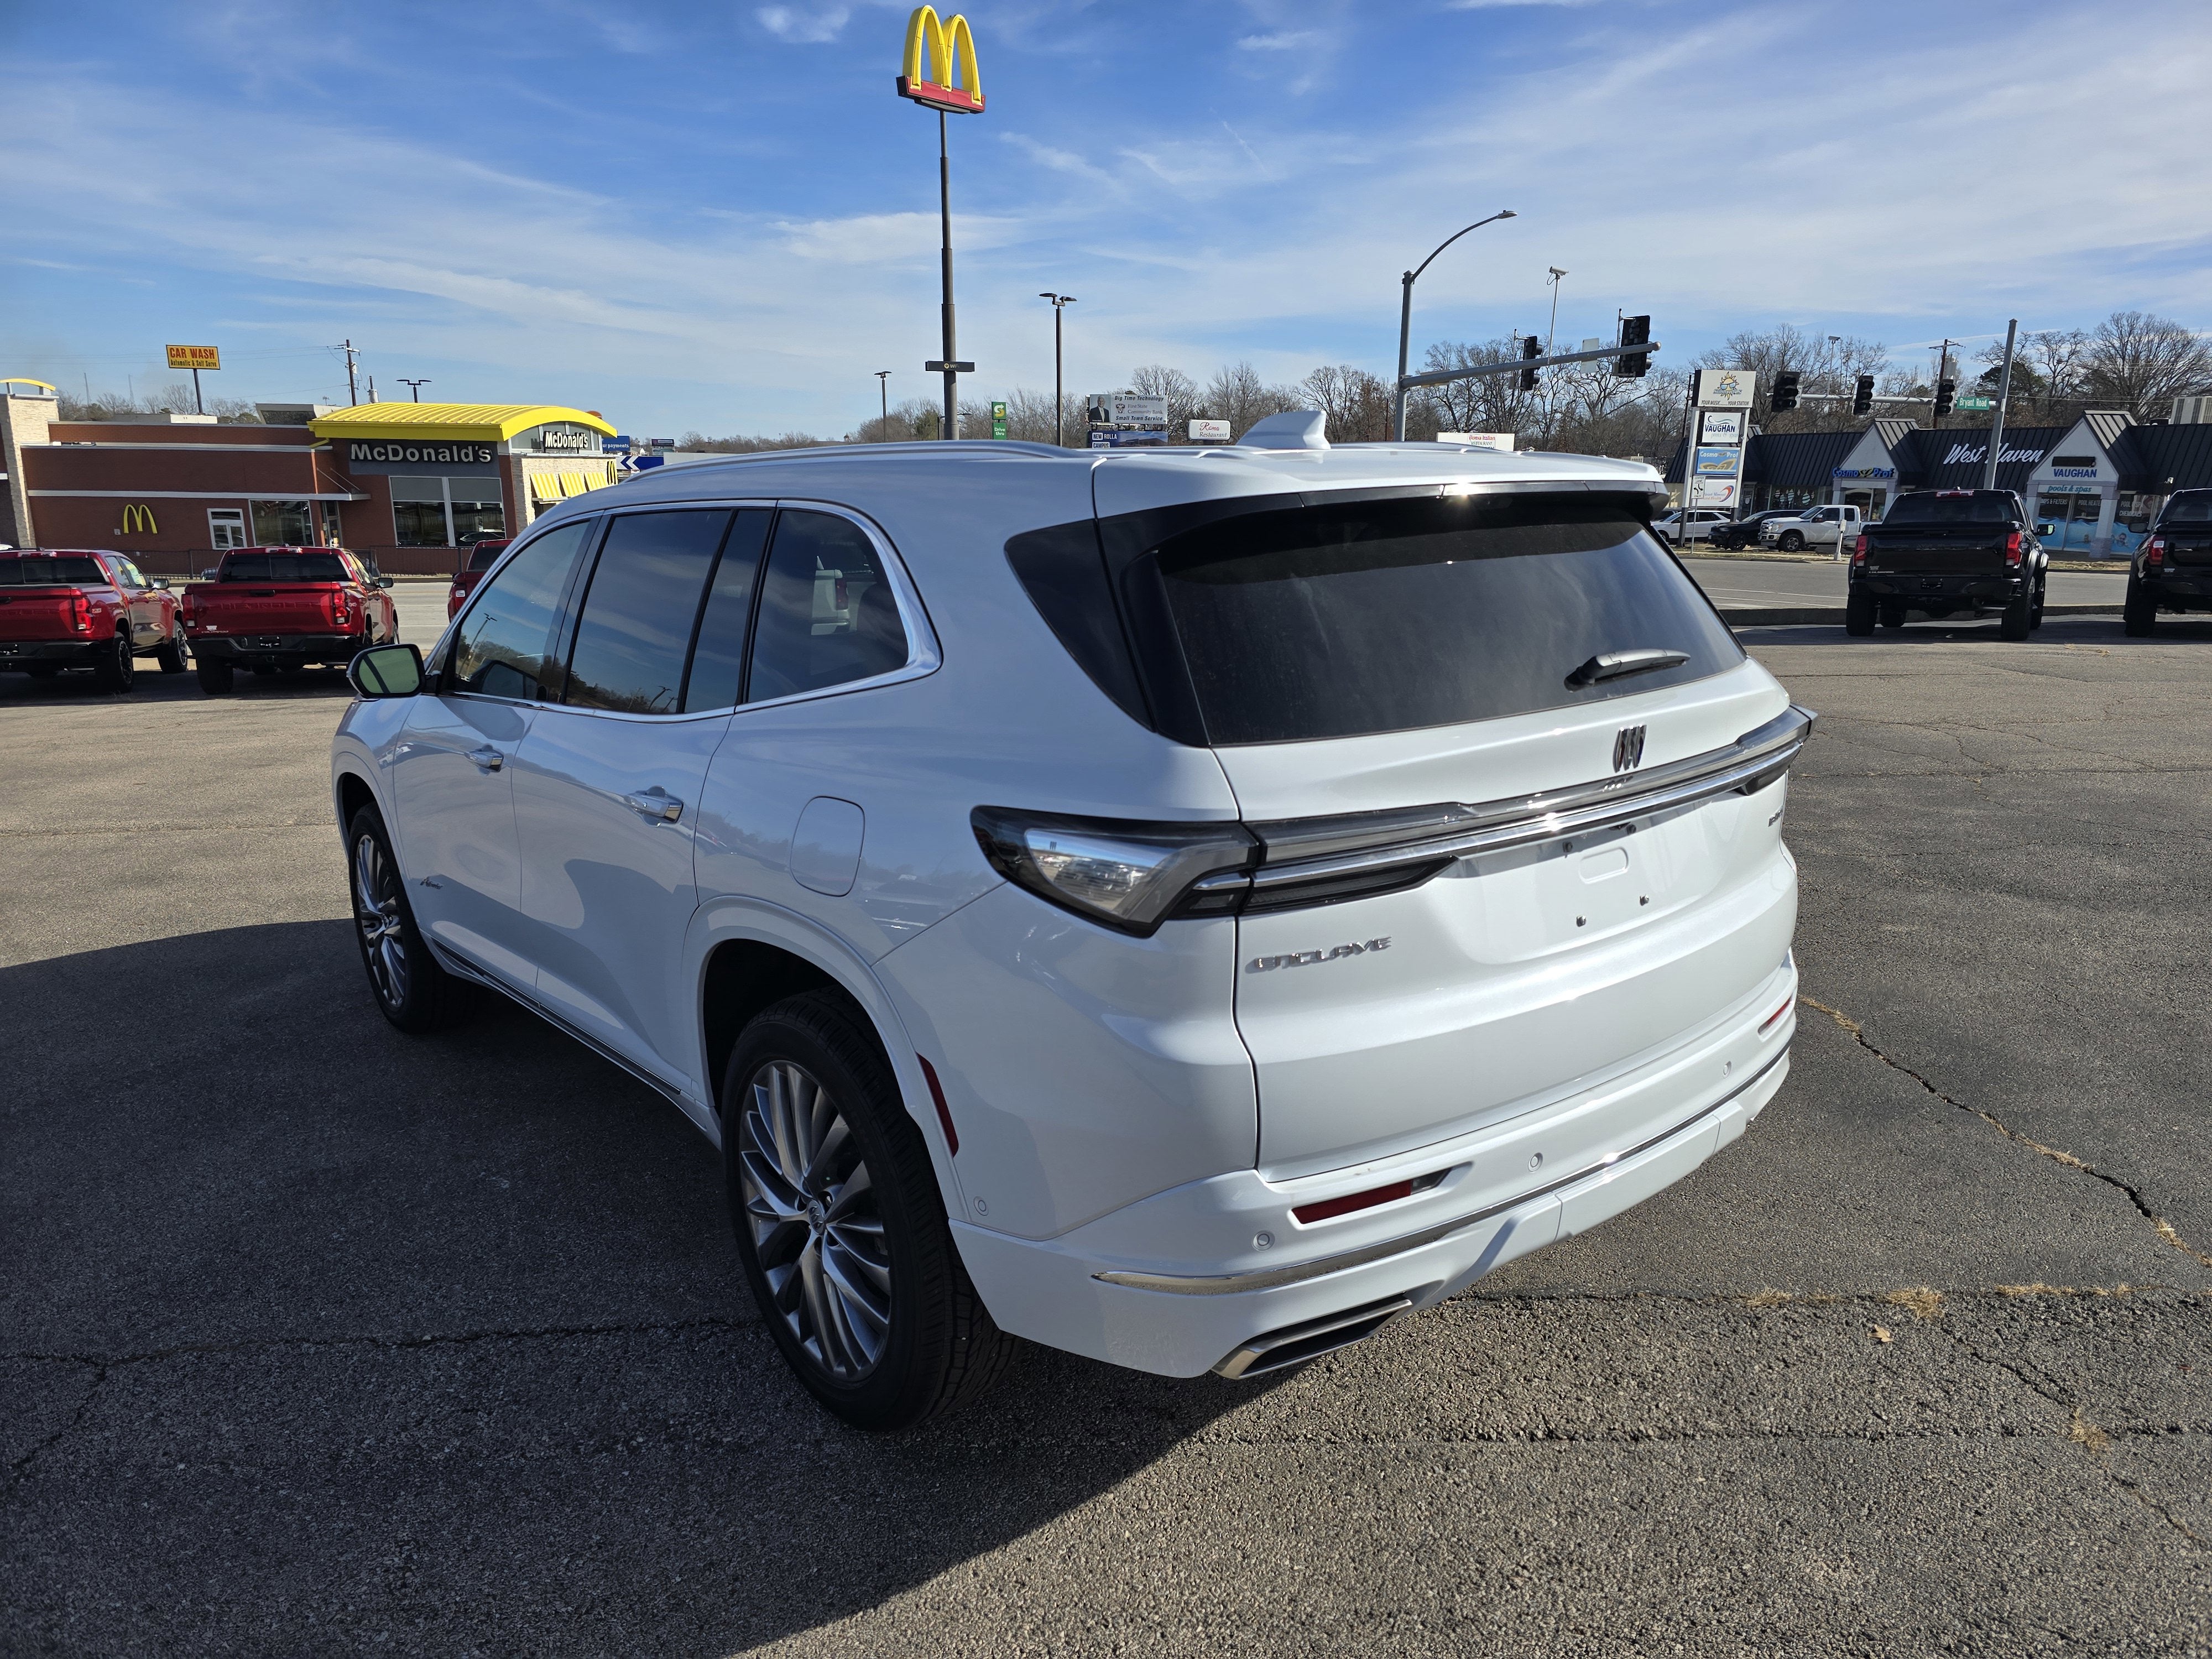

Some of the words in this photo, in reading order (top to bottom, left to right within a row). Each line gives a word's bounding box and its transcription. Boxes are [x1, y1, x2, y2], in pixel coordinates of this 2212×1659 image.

[170, 348, 187, 358] CAR
[190, 348, 215, 359] WASH
[1959, 397, 1974, 408] Bryant
[1976, 399, 1987, 407] Road
[1199, 422, 1220, 431] Roma
[1705, 424, 1735, 432] VAUGHAN
[545, 431, 588, 448] McDonald's
[351, 444, 492, 463] McDonald's
[1943, 443, 1988, 465] West
[1832, 467, 1859, 478] Cosmo
[1873, 468, 1895, 478] Prof
[2053, 468, 2097, 478] VAUGHAN
